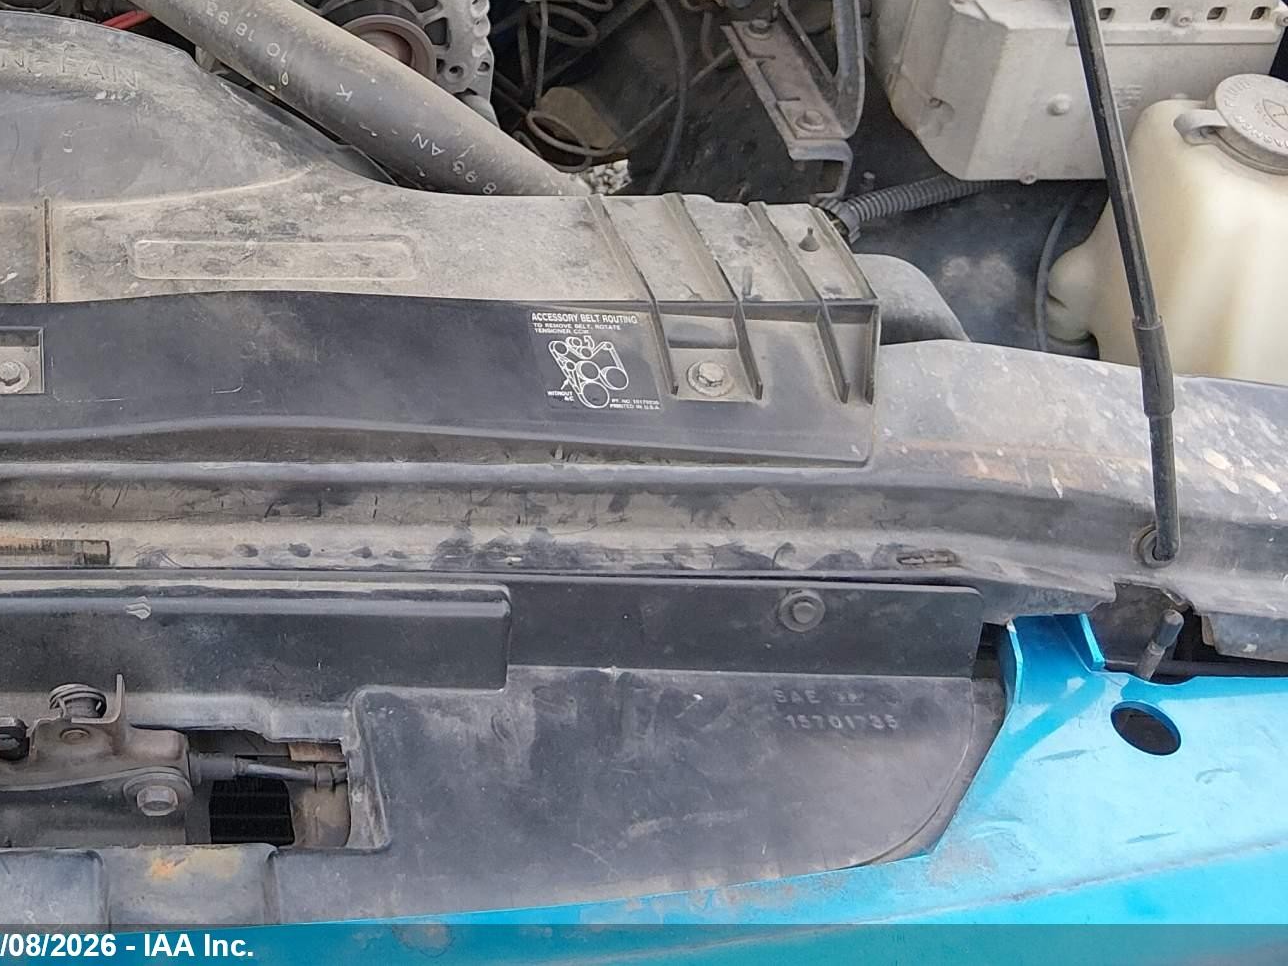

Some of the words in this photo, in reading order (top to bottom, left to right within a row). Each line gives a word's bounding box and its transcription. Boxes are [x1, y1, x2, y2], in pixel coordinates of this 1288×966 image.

[531, 312, 578, 322] ACCESSORY
[580, 314, 600, 323] BELT
[602, 314, 638, 324] ROUTING
[772, 689, 820, 705] SAE
